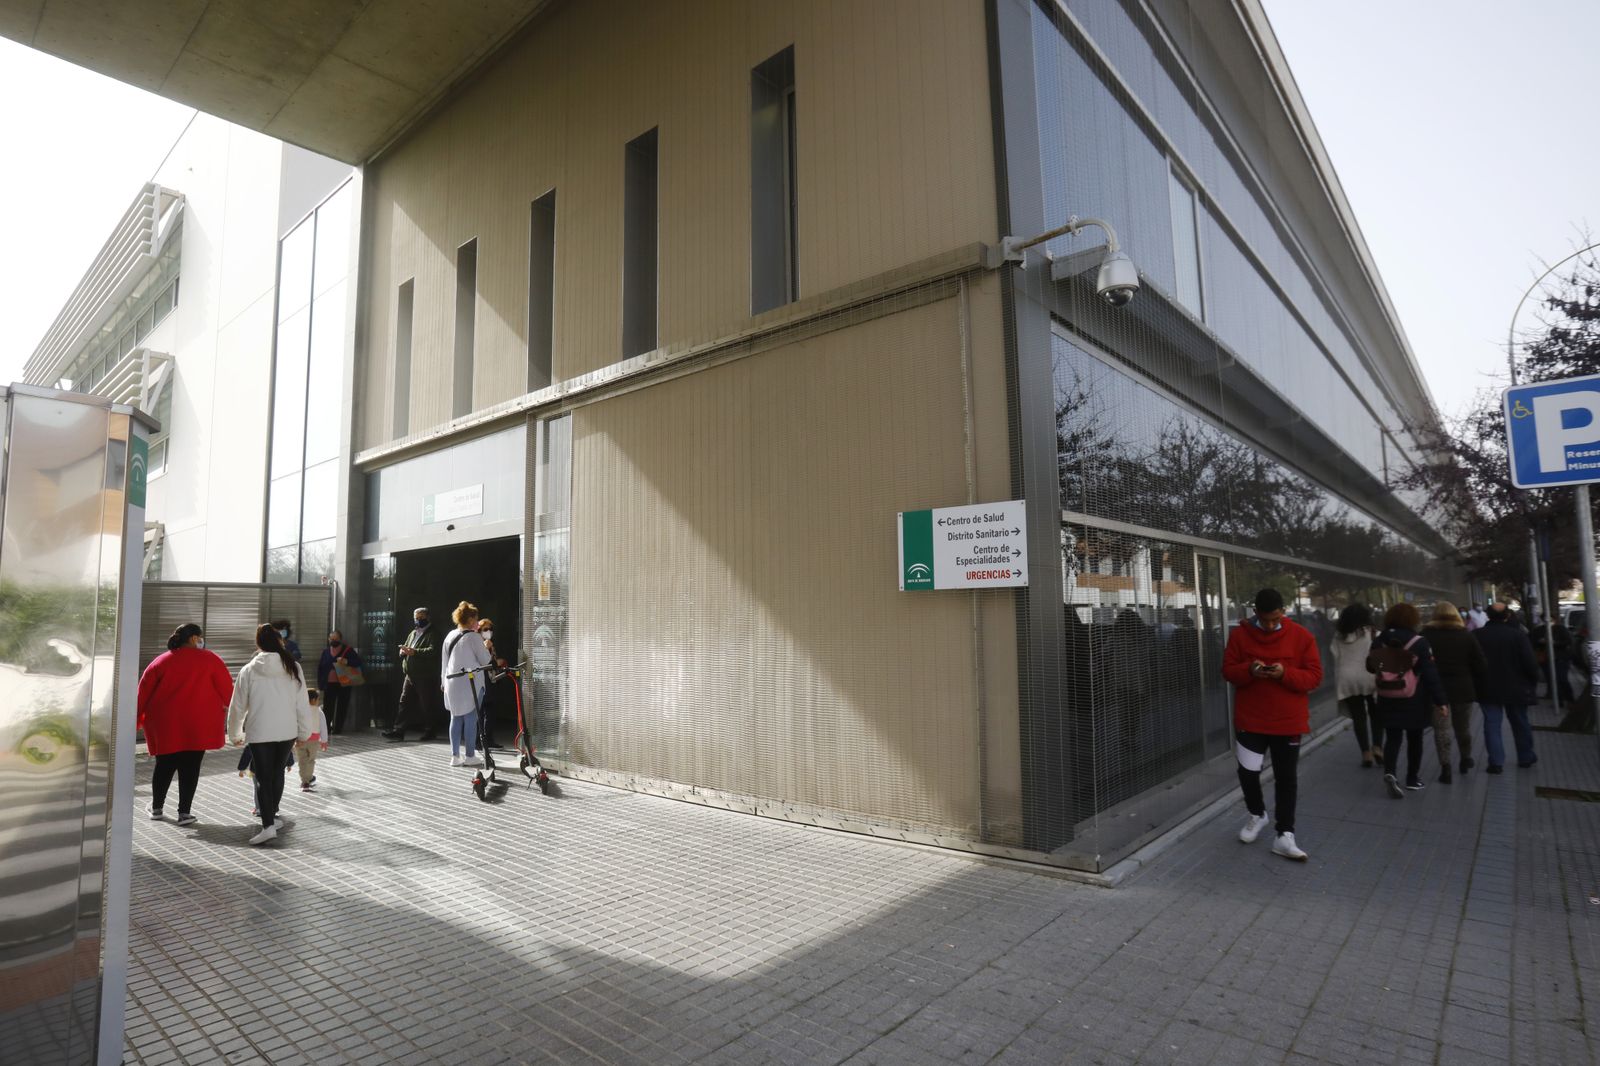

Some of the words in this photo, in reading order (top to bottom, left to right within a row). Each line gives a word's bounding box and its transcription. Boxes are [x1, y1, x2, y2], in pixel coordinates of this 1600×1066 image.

[1533, 390, 1600, 473] P
[946, 517, 971, 526] Centro
[972, 515, 981, 524] de
[983, 512, 1005, 522] Salud
[947, 531, 974, 541] Distrito
[975, 528, 1010, 539] Sanitario
[973, 545, 999, 554] Centro
[1000, 544, 1010, 553] de
[956, 554, 1011, 567] Especialidades
[966, 569, 1011, 580] URGENCIAS
